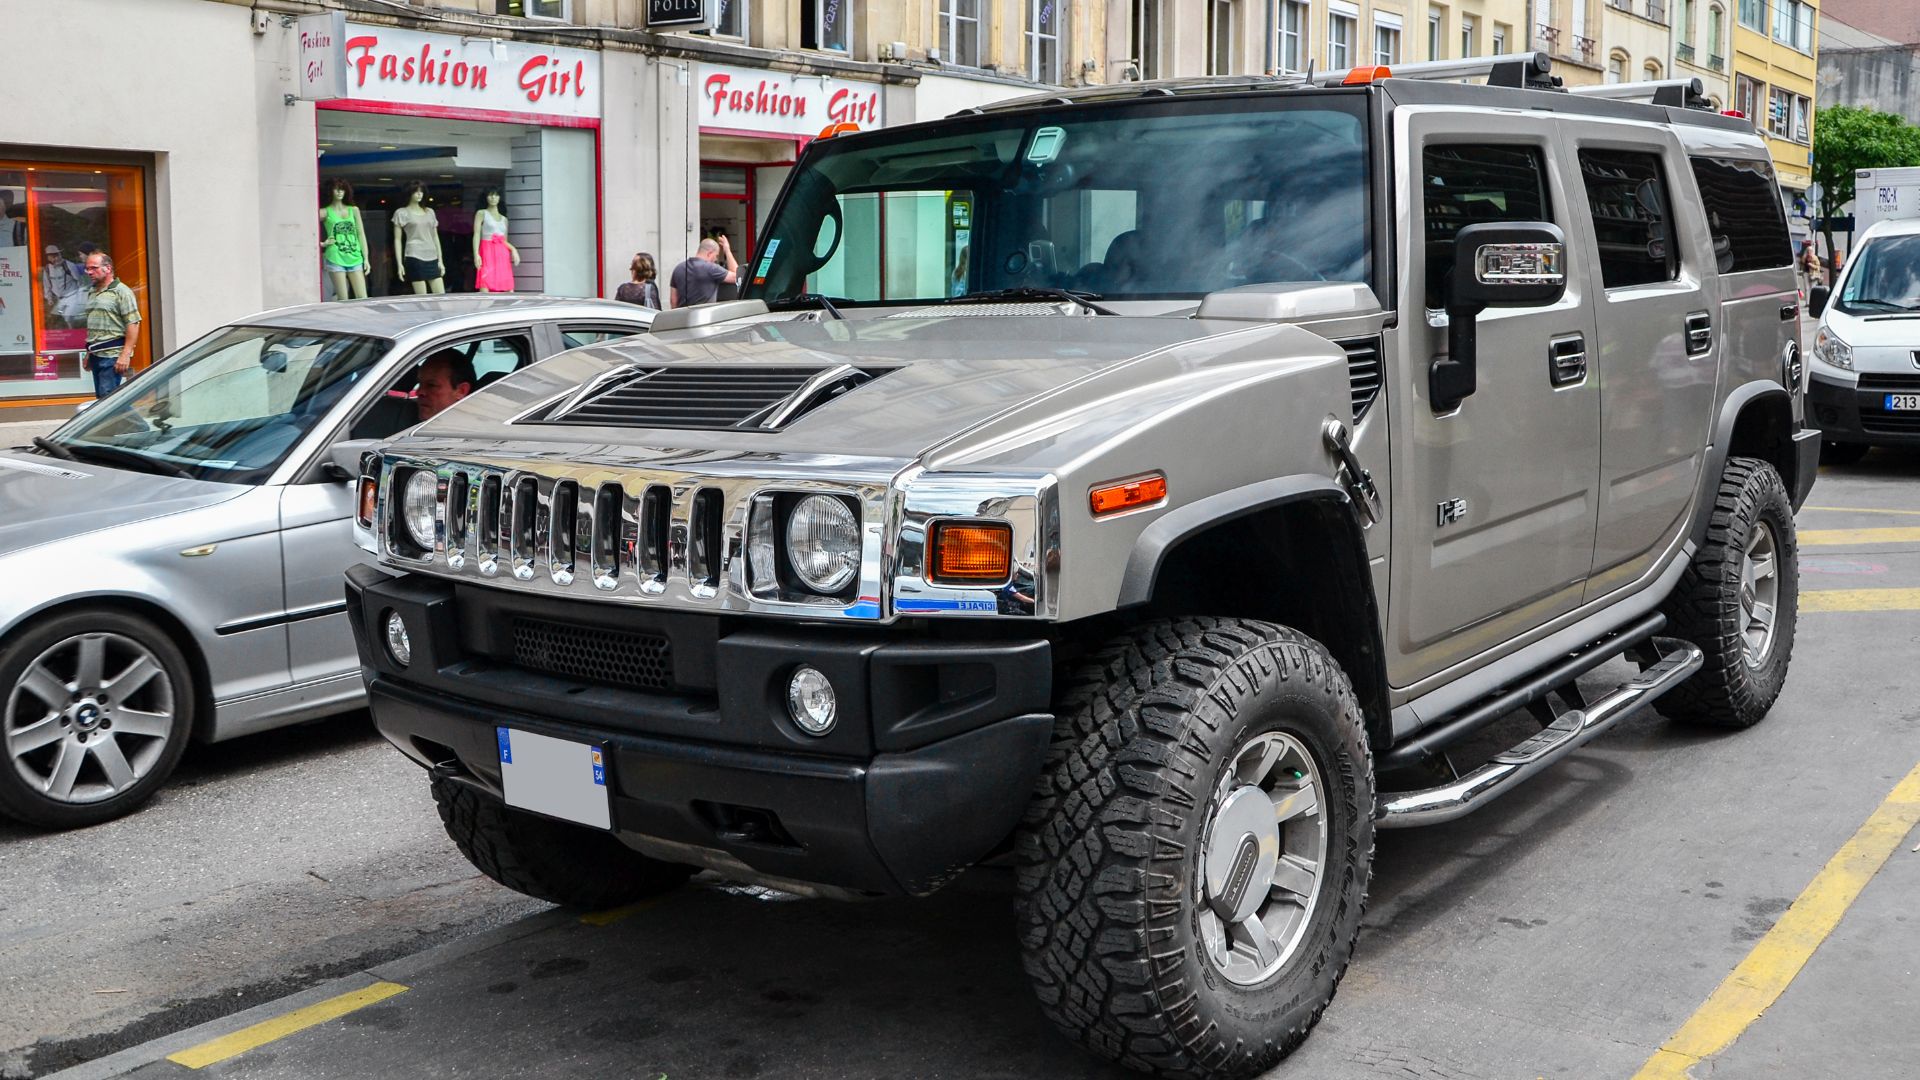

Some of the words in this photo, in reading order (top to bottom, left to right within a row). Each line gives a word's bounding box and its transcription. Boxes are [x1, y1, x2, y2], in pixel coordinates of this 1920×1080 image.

[300, 32, 331, 54] Fashion
[306, 60, 324, 83] Girl
[346, 36, 488, 88] Fashion
[518, 55, 585, 102] Girl
[705, 74, 806, 117] Fashion
[827, 88, 877, 124] Girl
[1878, 187, 1898, 204] FRC-X
[1893, 396, 1917, 409] 213
[503, 749, 508, 760] F
[595, 770, 603, 782] 54
